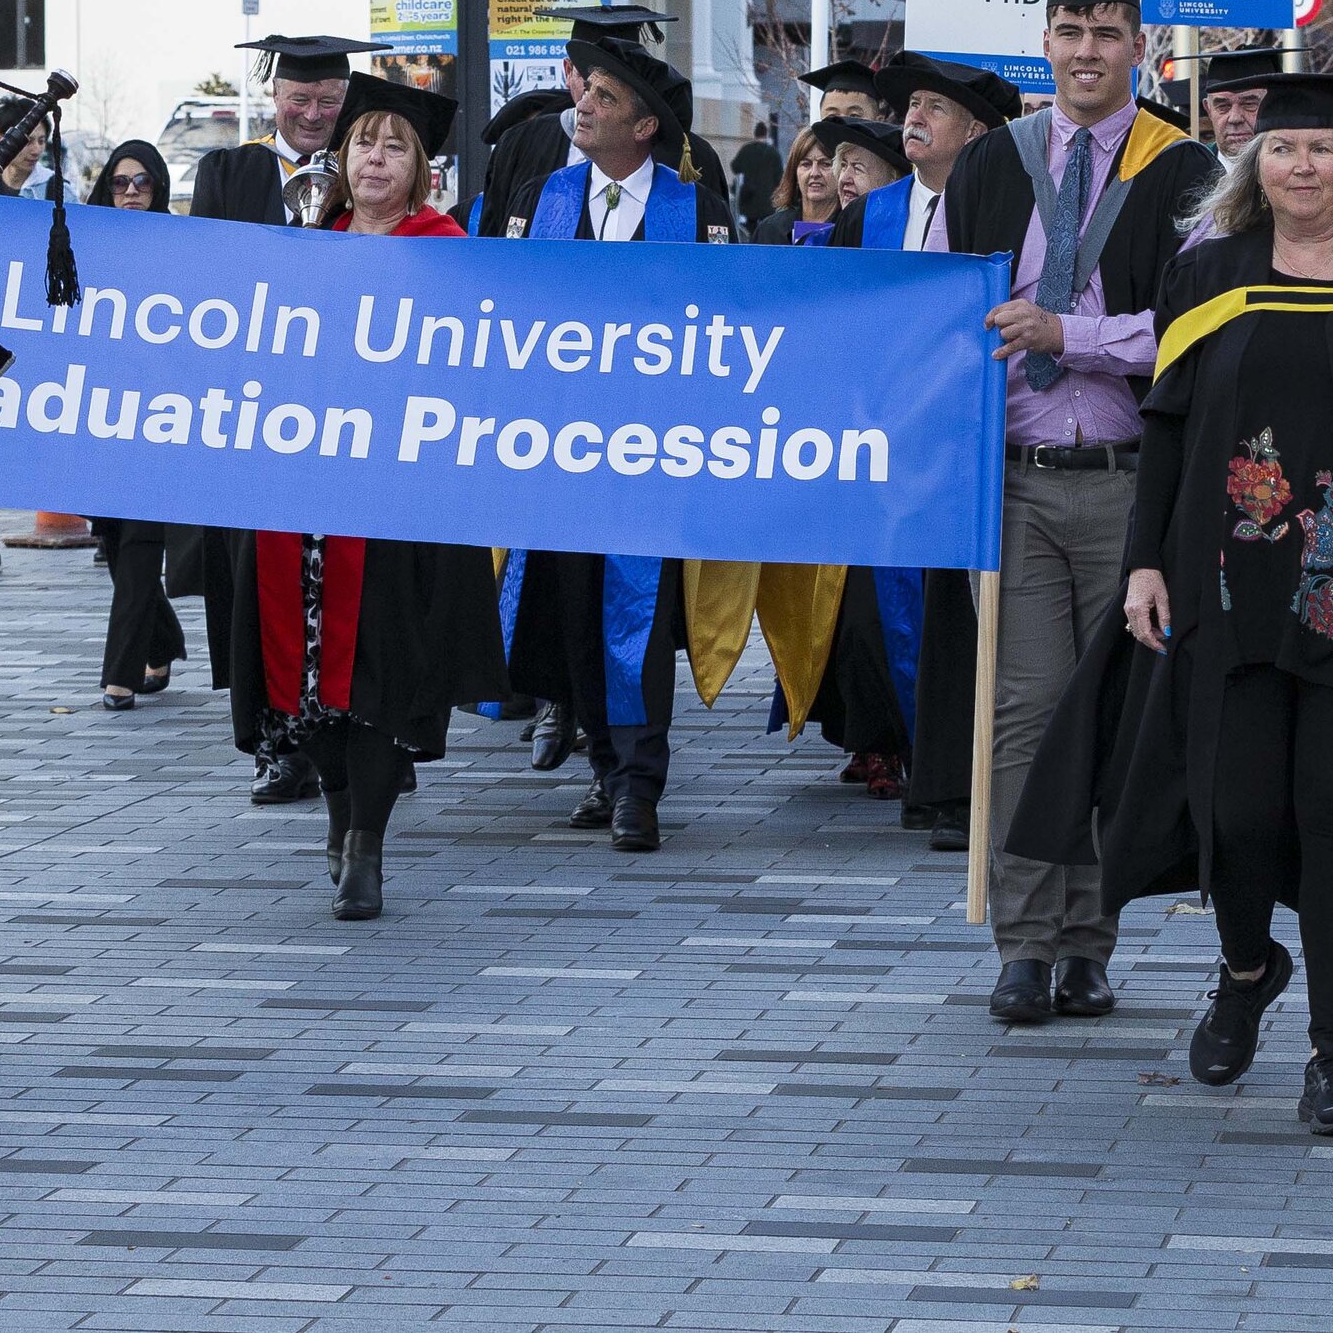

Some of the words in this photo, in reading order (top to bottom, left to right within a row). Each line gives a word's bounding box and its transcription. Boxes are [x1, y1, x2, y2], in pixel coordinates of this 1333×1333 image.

[395, 0, 452, 10] childcare
[497, 5, 532, 13] natural
[421, 12, 450, 22] years
[497, 15, 522, 24] right
[523, 15, 533, 23] in
[535, 15, 550, 23] the
[505, 45, 526, 56] 021
[528, 45, 548, 56] 986
[1003, 64, 1045, 73] LINCOLN
[1003, 71, 1055, 80] UNIVERSIT
[0, 259, 320, 358] Lincoln
[353, 292, 785, 394] University
[398, 395, 889, 484] Procession
